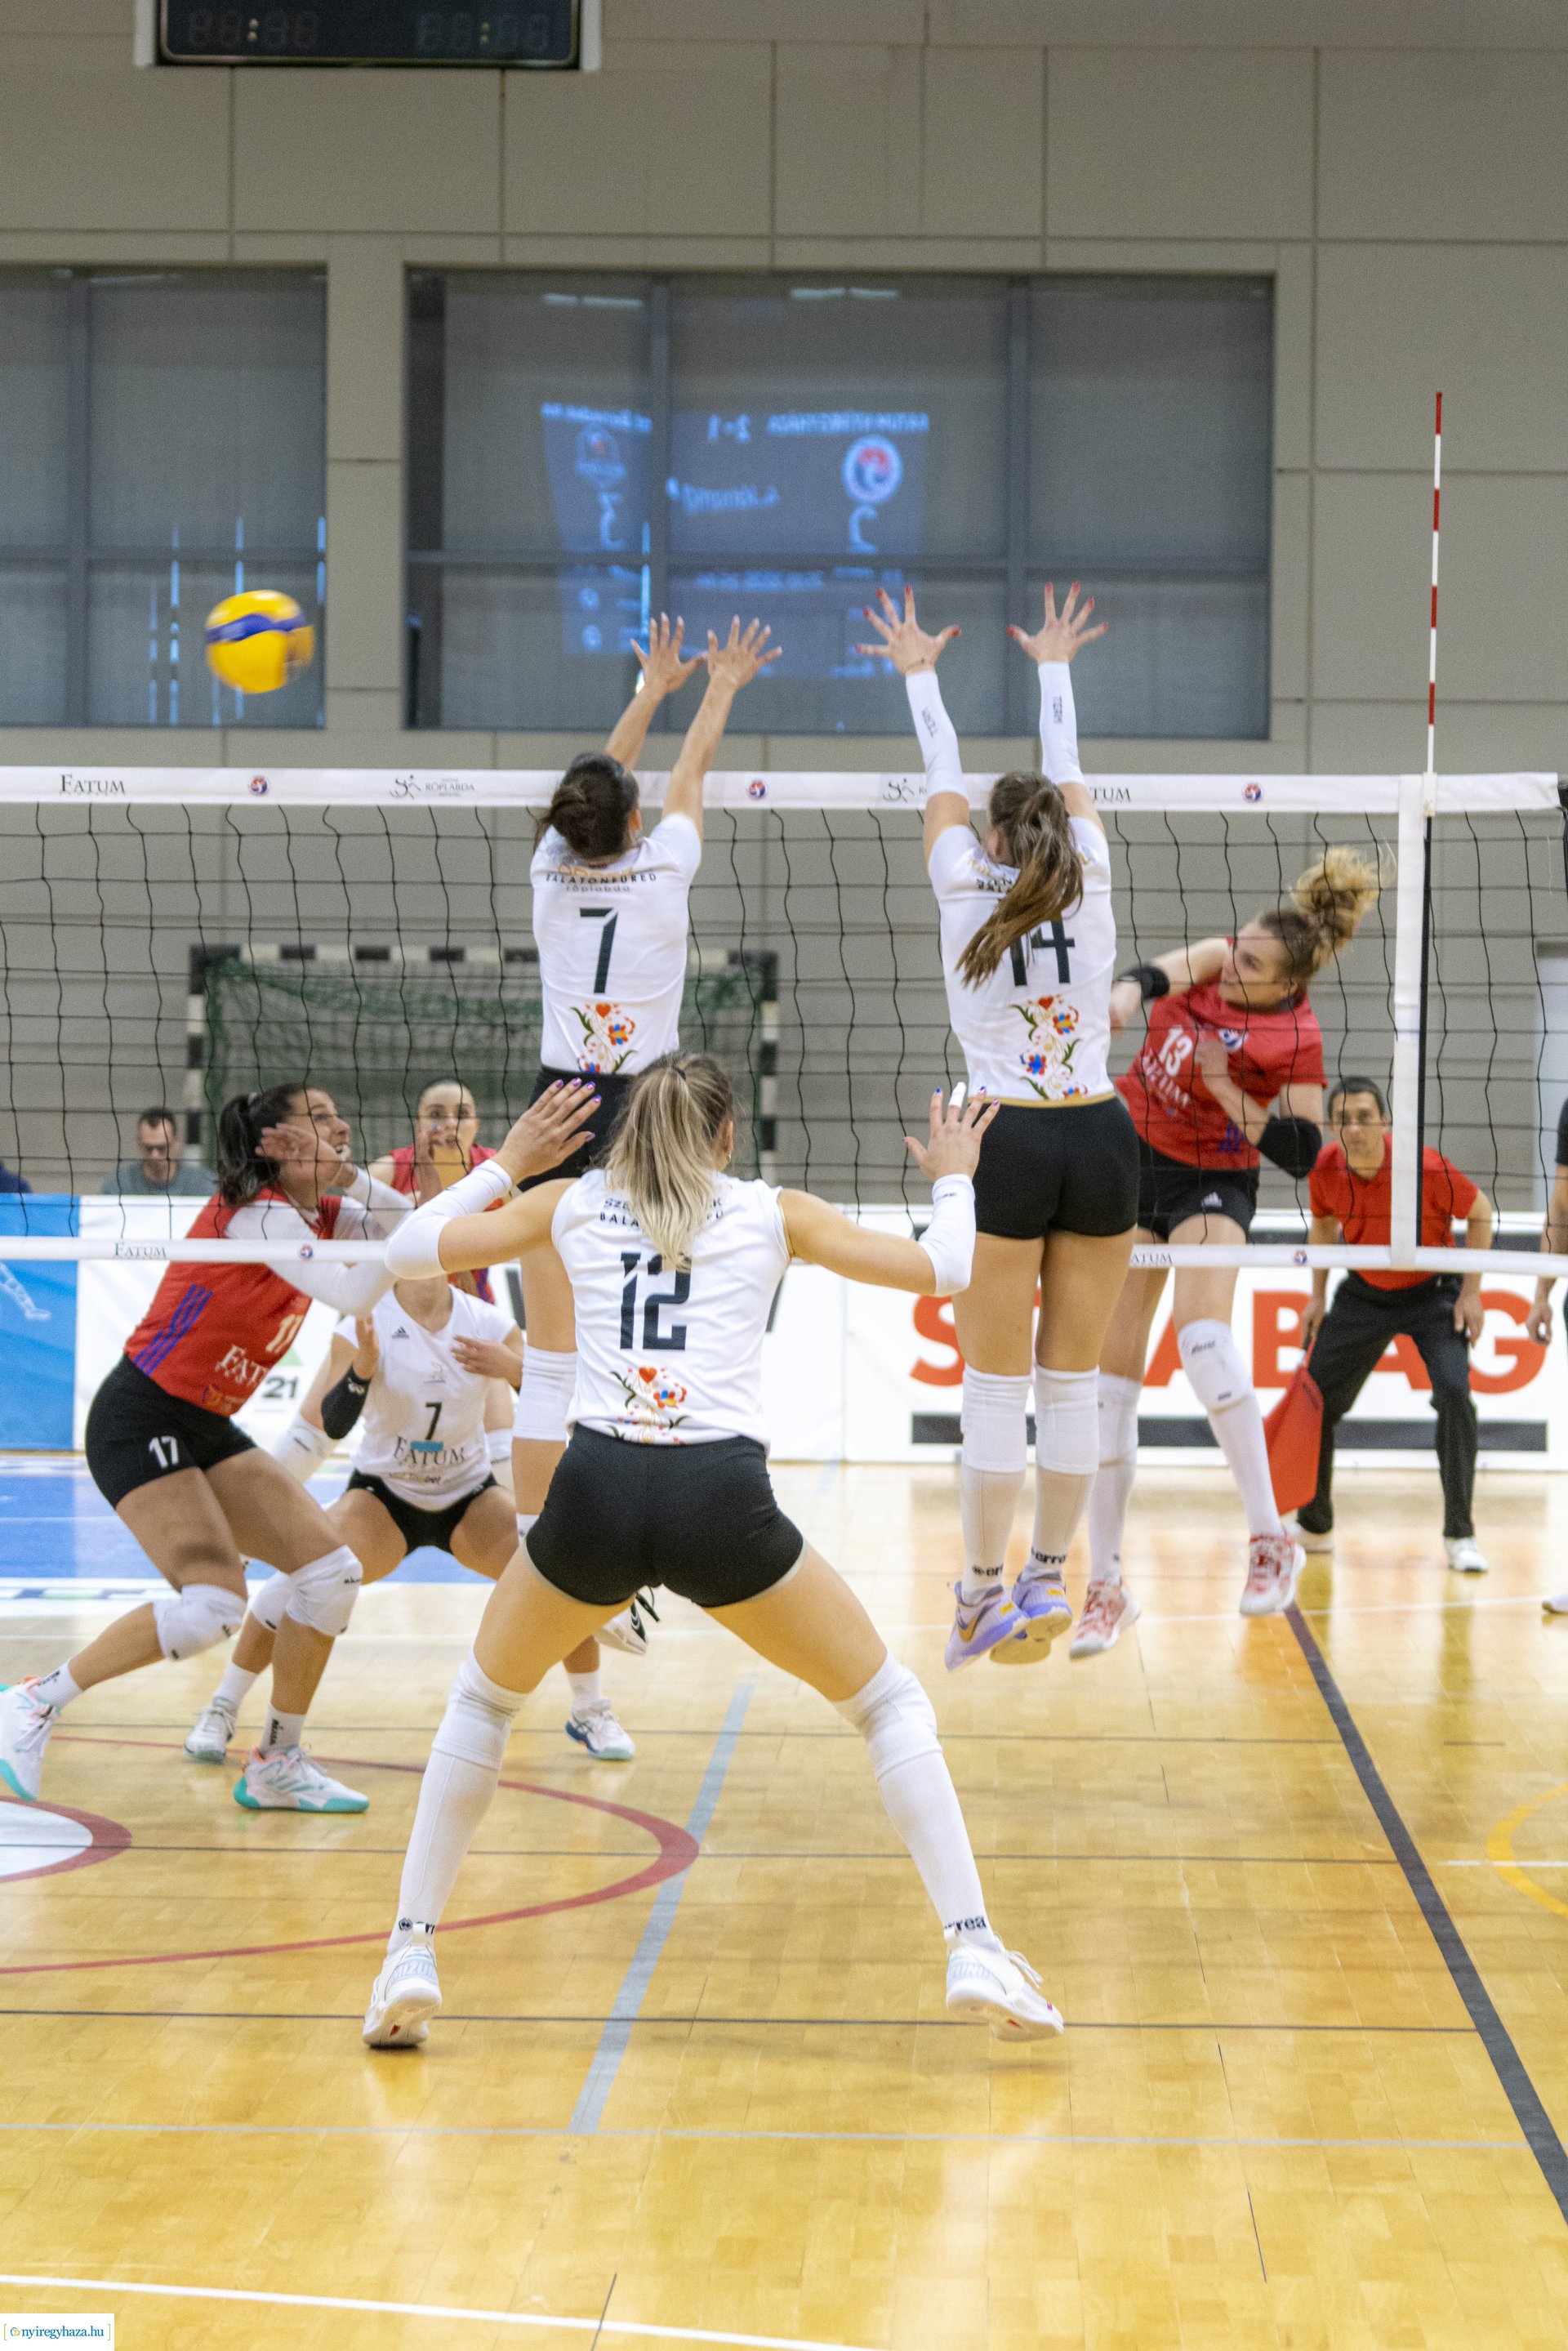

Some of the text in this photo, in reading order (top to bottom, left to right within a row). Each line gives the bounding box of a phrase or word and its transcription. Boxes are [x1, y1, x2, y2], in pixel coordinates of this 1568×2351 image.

[60, 773, 126, 794] FATUM
[1091, 787, 1131, 803] TUM
[580, 908, 618, 993] 7
[1009, 917, 1076, 987] 14
[1158, 1025, 1193, 1077] 13
[114, 1242, 167, 1258] FATUM
[1130, 1253, 1173, 1265] ATUM
[620, 1252, 692, 1351] 12
[216, 1344, 270, 1386] FAT
[425, 1402, 442, 1440] 7
[149, 1435, 179, 1468] 17
